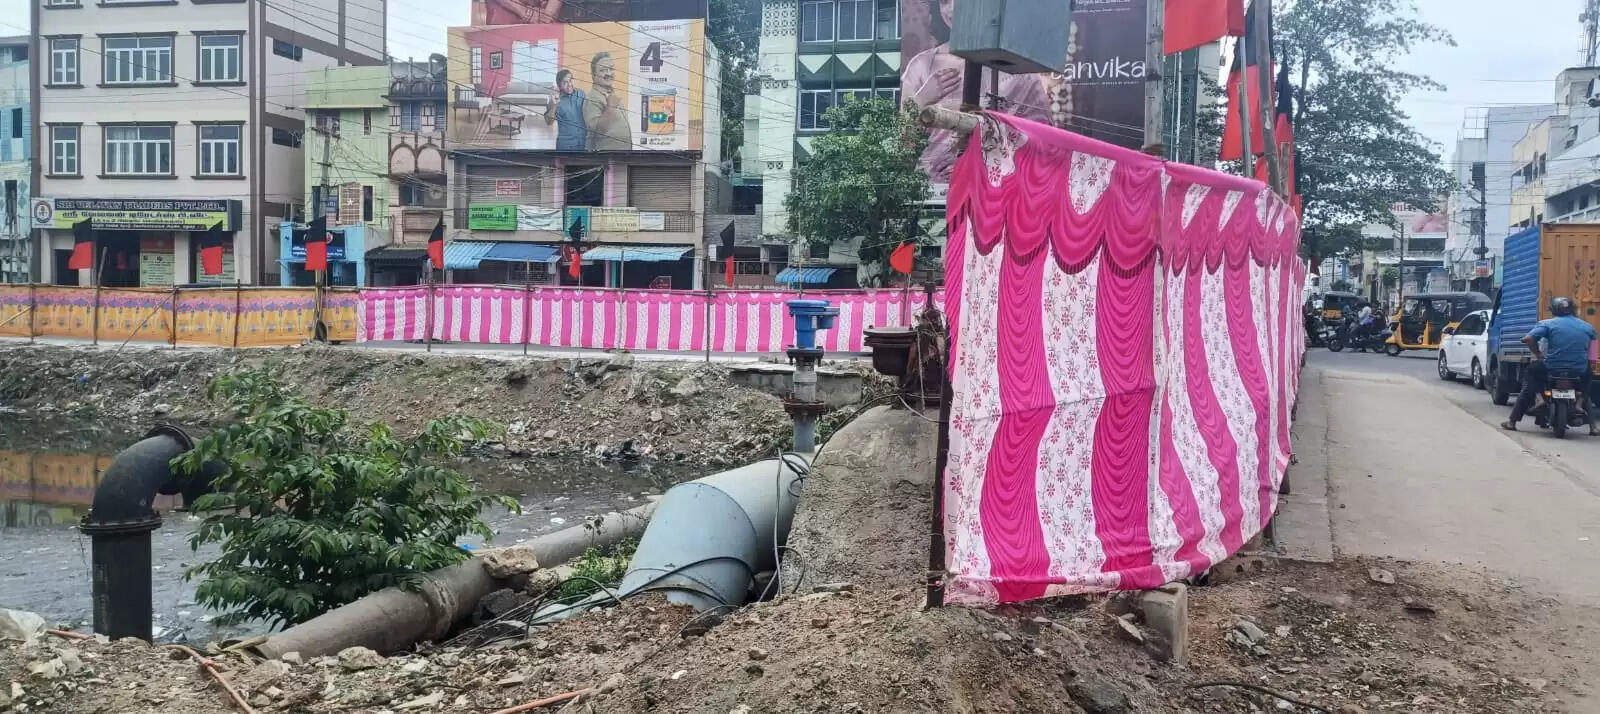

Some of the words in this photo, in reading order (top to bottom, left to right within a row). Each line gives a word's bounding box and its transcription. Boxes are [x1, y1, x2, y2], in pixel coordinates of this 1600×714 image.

[639, 41, 664, 73] 4
[56, 200, 75, 209] SRI
[124, 201, 173, 210] TRADERS
